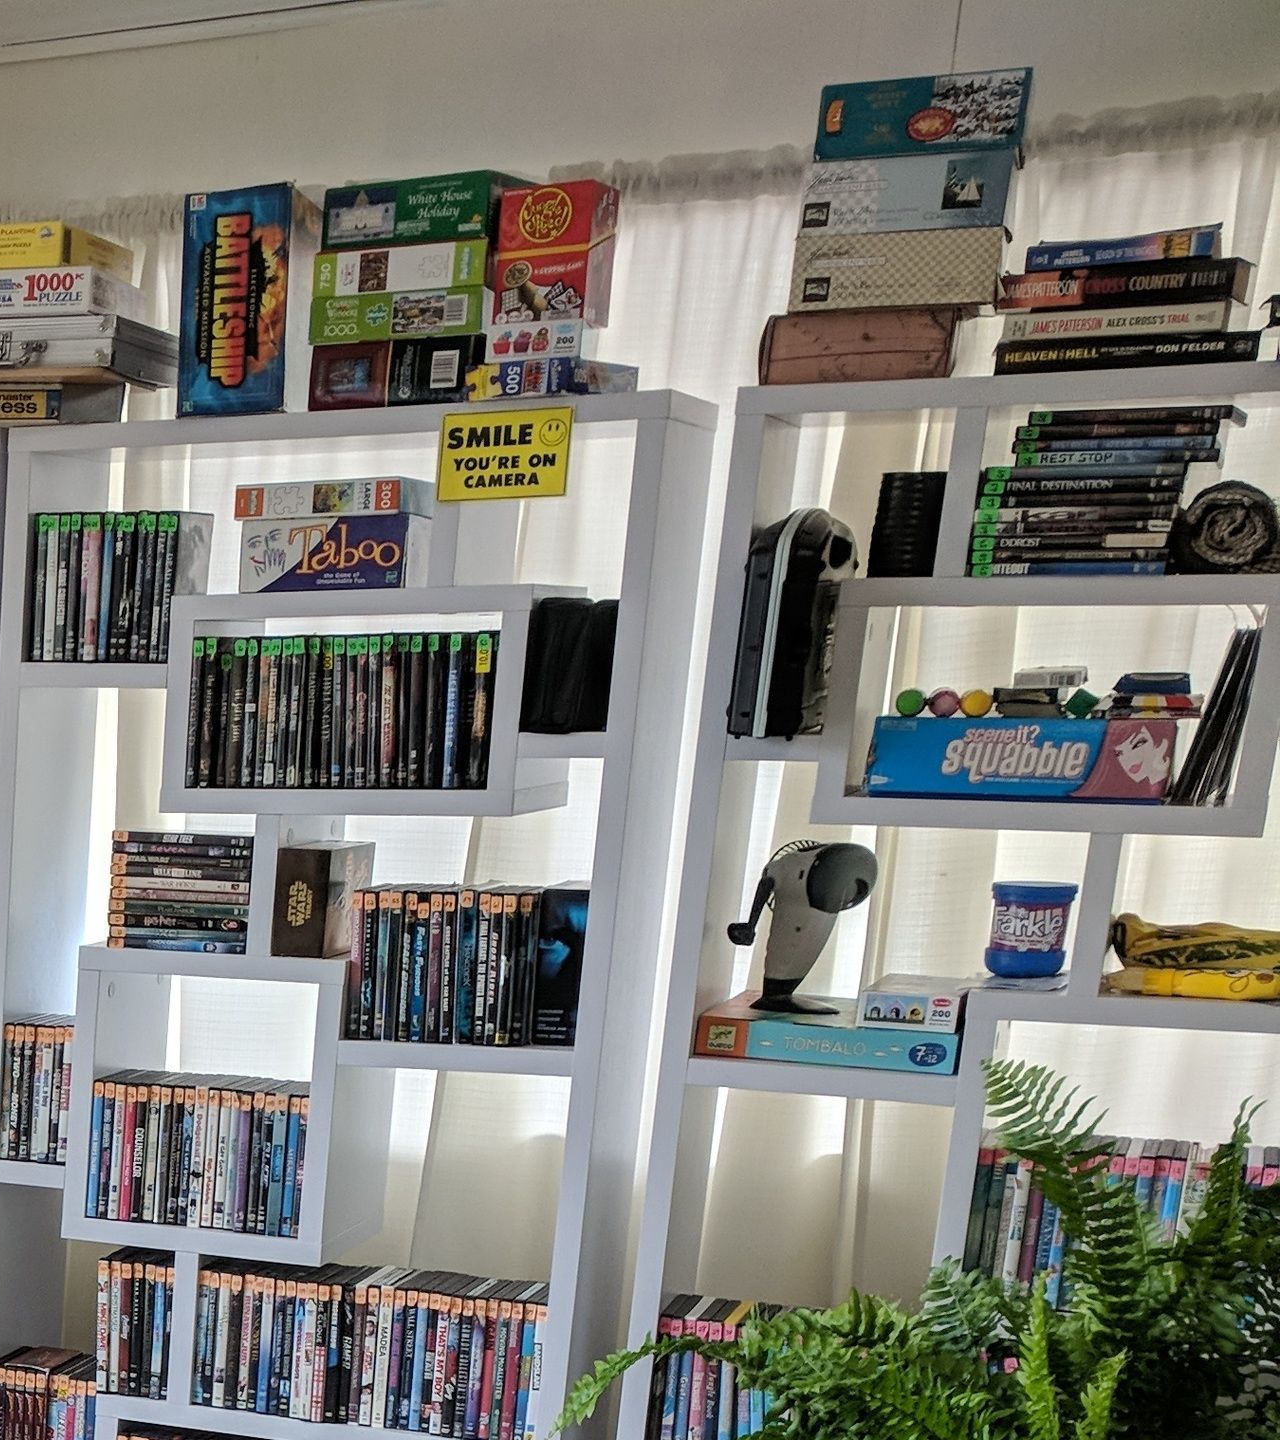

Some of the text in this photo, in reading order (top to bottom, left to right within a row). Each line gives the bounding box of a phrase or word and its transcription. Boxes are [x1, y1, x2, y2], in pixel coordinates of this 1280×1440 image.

[408, 187, 472, 205] White House
[417, 205, 460, 219] Holiday
[23, 272, 75, 301] 1000
[202, 247, 211, 307] ADVANCED
[1129, 274, 1187, 291] COUNTRY
[38, 292, 83, 302] PUZZLE
[210, 215, 250, 386] BATTLESHIP
[1031, 321, 1058, 334] JAMES
[1059, 318, 1104, 332] PATTERSON
[1106, 318, 1127, 328] ALEX
[1168, 314, 1189, 323] TRIAL
[1005, 351, 1059, 362] HEAVEN
[1066, 348, 1099, 361] HELL
[1156, 344, 1180, 353] DON
[1182, 341, 1225, 352] FELDER
[505, 365, 520, 394] 500
[447, 424, 534, 450] SMILE
[453, 454, 556, 472] YOU'RE ON
[1040, 453, 1113, 465] REST STOP
[464, 472, 540, 489] CAMERA
[1041, 479, 1113, 490] DESTINATION
[380, 481, 392, 509] 300
[288, 524, 401, 575] Taboo
[286, 882, 301, 927] STAR
[295, 880, 309, 927] WARS
[995, 905, 1063, 938] Farkle
[931, 1009, 950, 1018] 200
[783, 1035, 867, 1057] TOMBALO
[10, 1092, 19, 1129] MONEY
[132, 1128, 145, 1178] COUNSELOR
[379, 1326, 389, 1357] MADEA
[437, 1324, 448, 1357] THAT'S
[495, 1327, 507, 1400] MOVING McALLISTER
[533, 1344, 542, 1390] BANDSLAM
[432, 1377, 443, 1399] BOY
